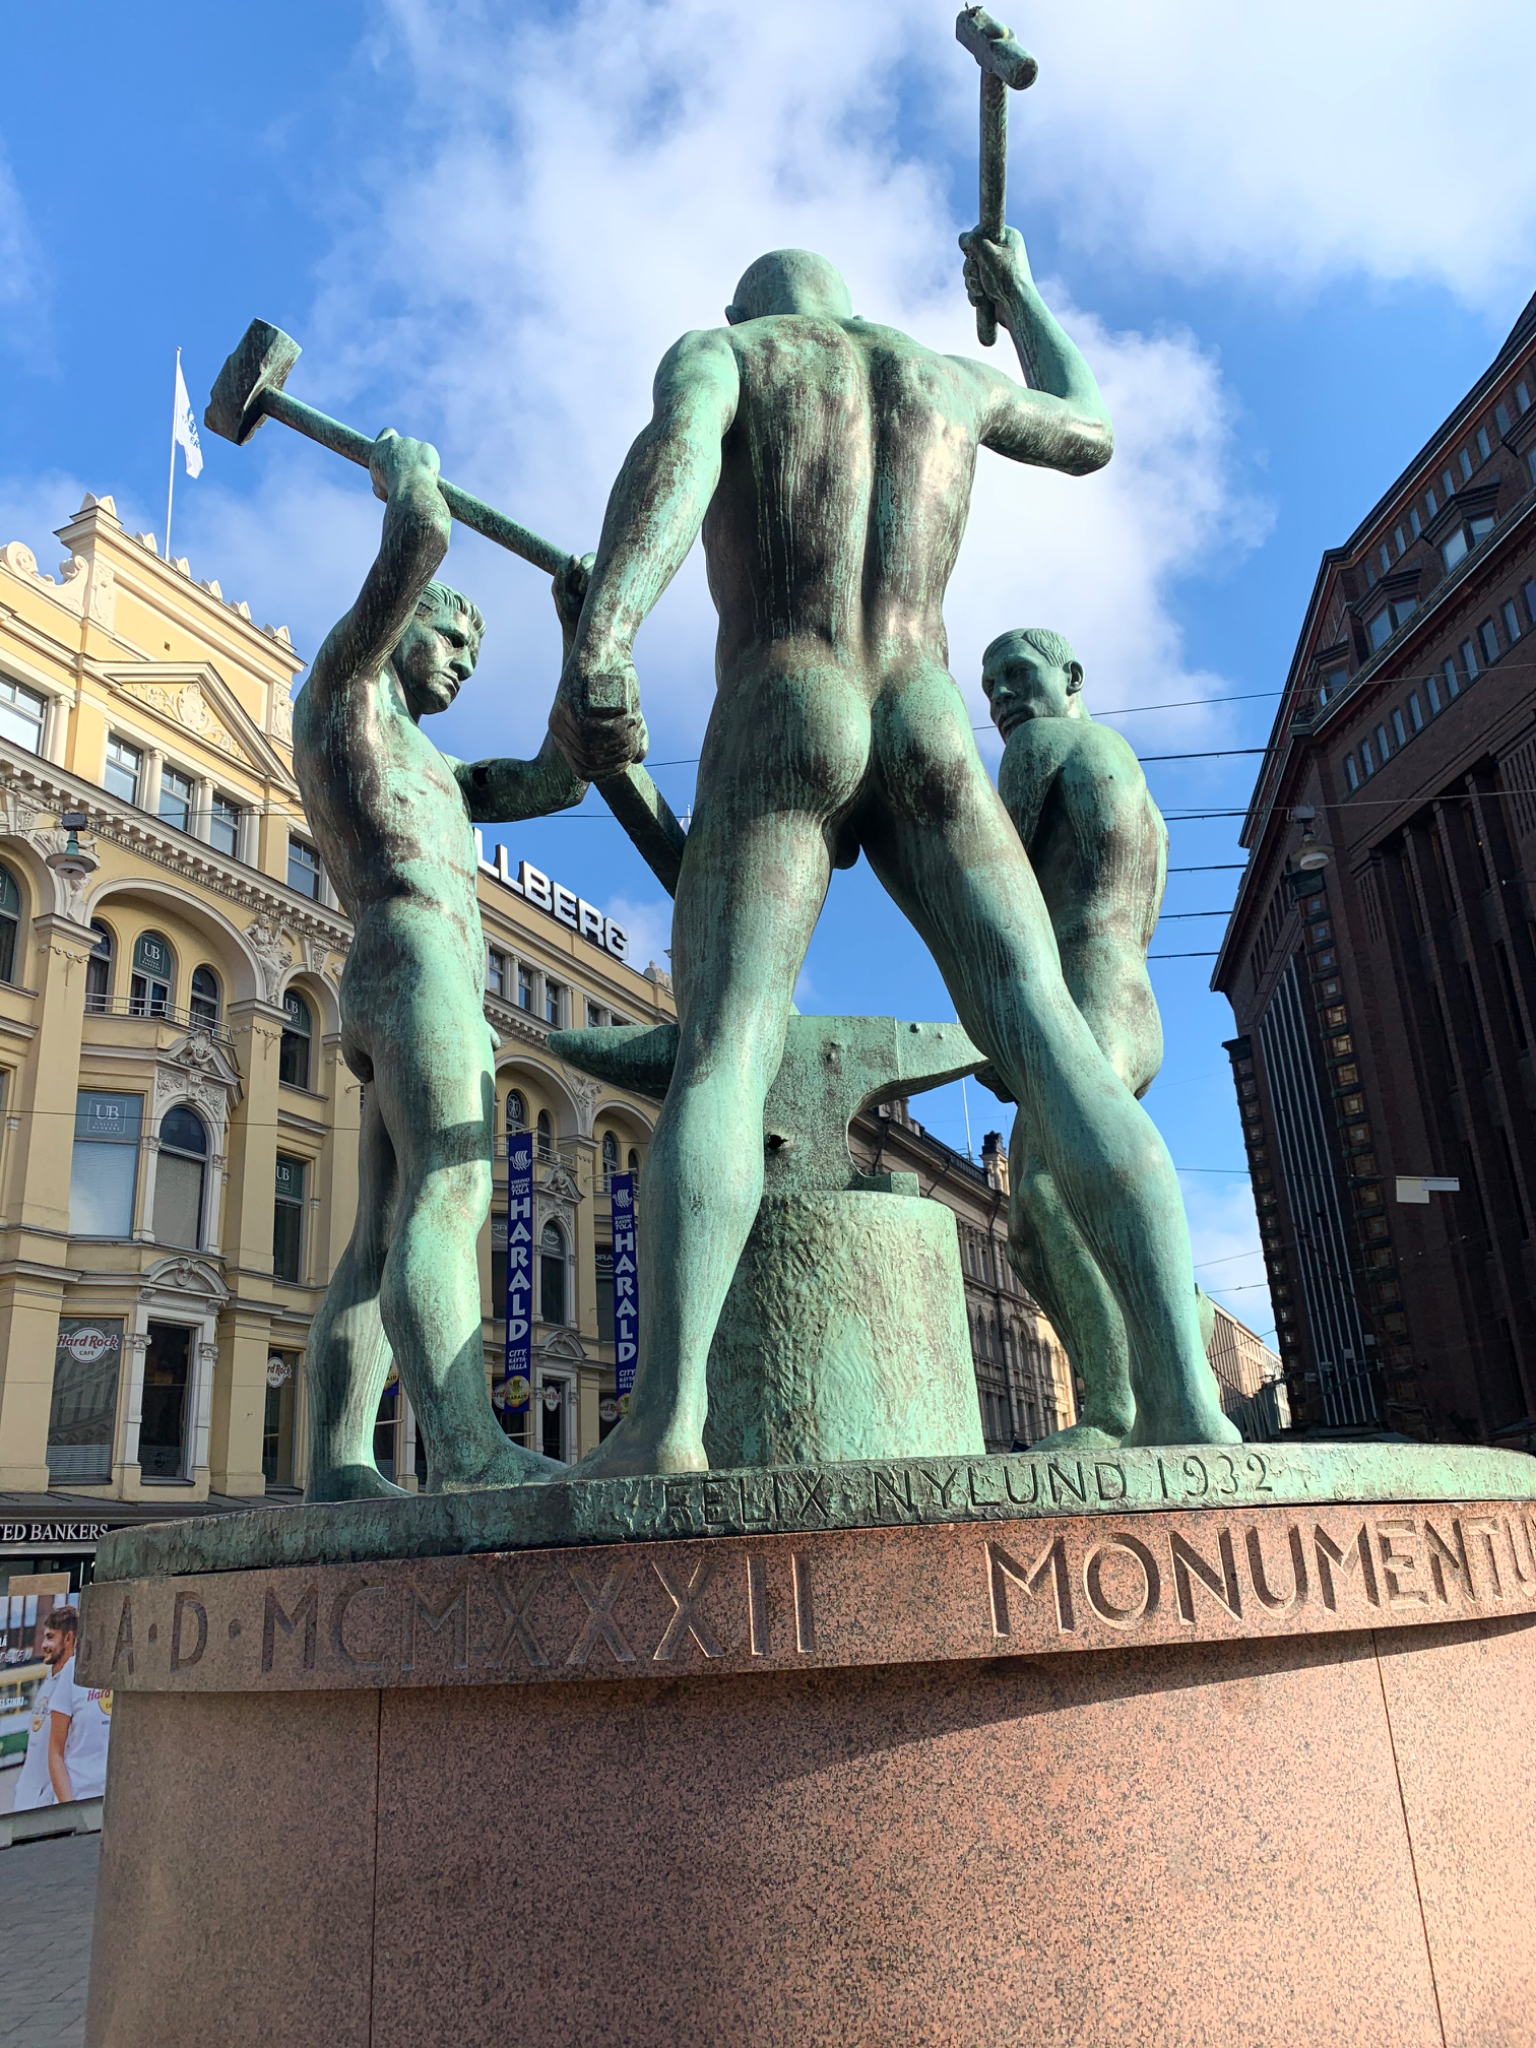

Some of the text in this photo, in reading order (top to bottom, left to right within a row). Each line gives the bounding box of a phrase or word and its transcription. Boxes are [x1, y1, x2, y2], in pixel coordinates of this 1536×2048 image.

[474, 826, 630, 962] LLBERG
[144, 942, 160, 960] UB
[285, 998, 299, 1014] UB
[95, 1104, 119, 1120] UB
[276, 1165, 290, 1181] UB
[512, 1188, 530, 1196] TOLA
[508, 1197, 532, 1342] HARALD
[615, 1232, 637, 1363] HARALD
[57, 1334, 119, 1349] Hard Rock
[663, 1453, 1274, 1525] FELIX NYLUND 1932
[29, 1524, 108, 1540] BANKERS
[985, 1513, 1536, 1638] MONUMENTU
